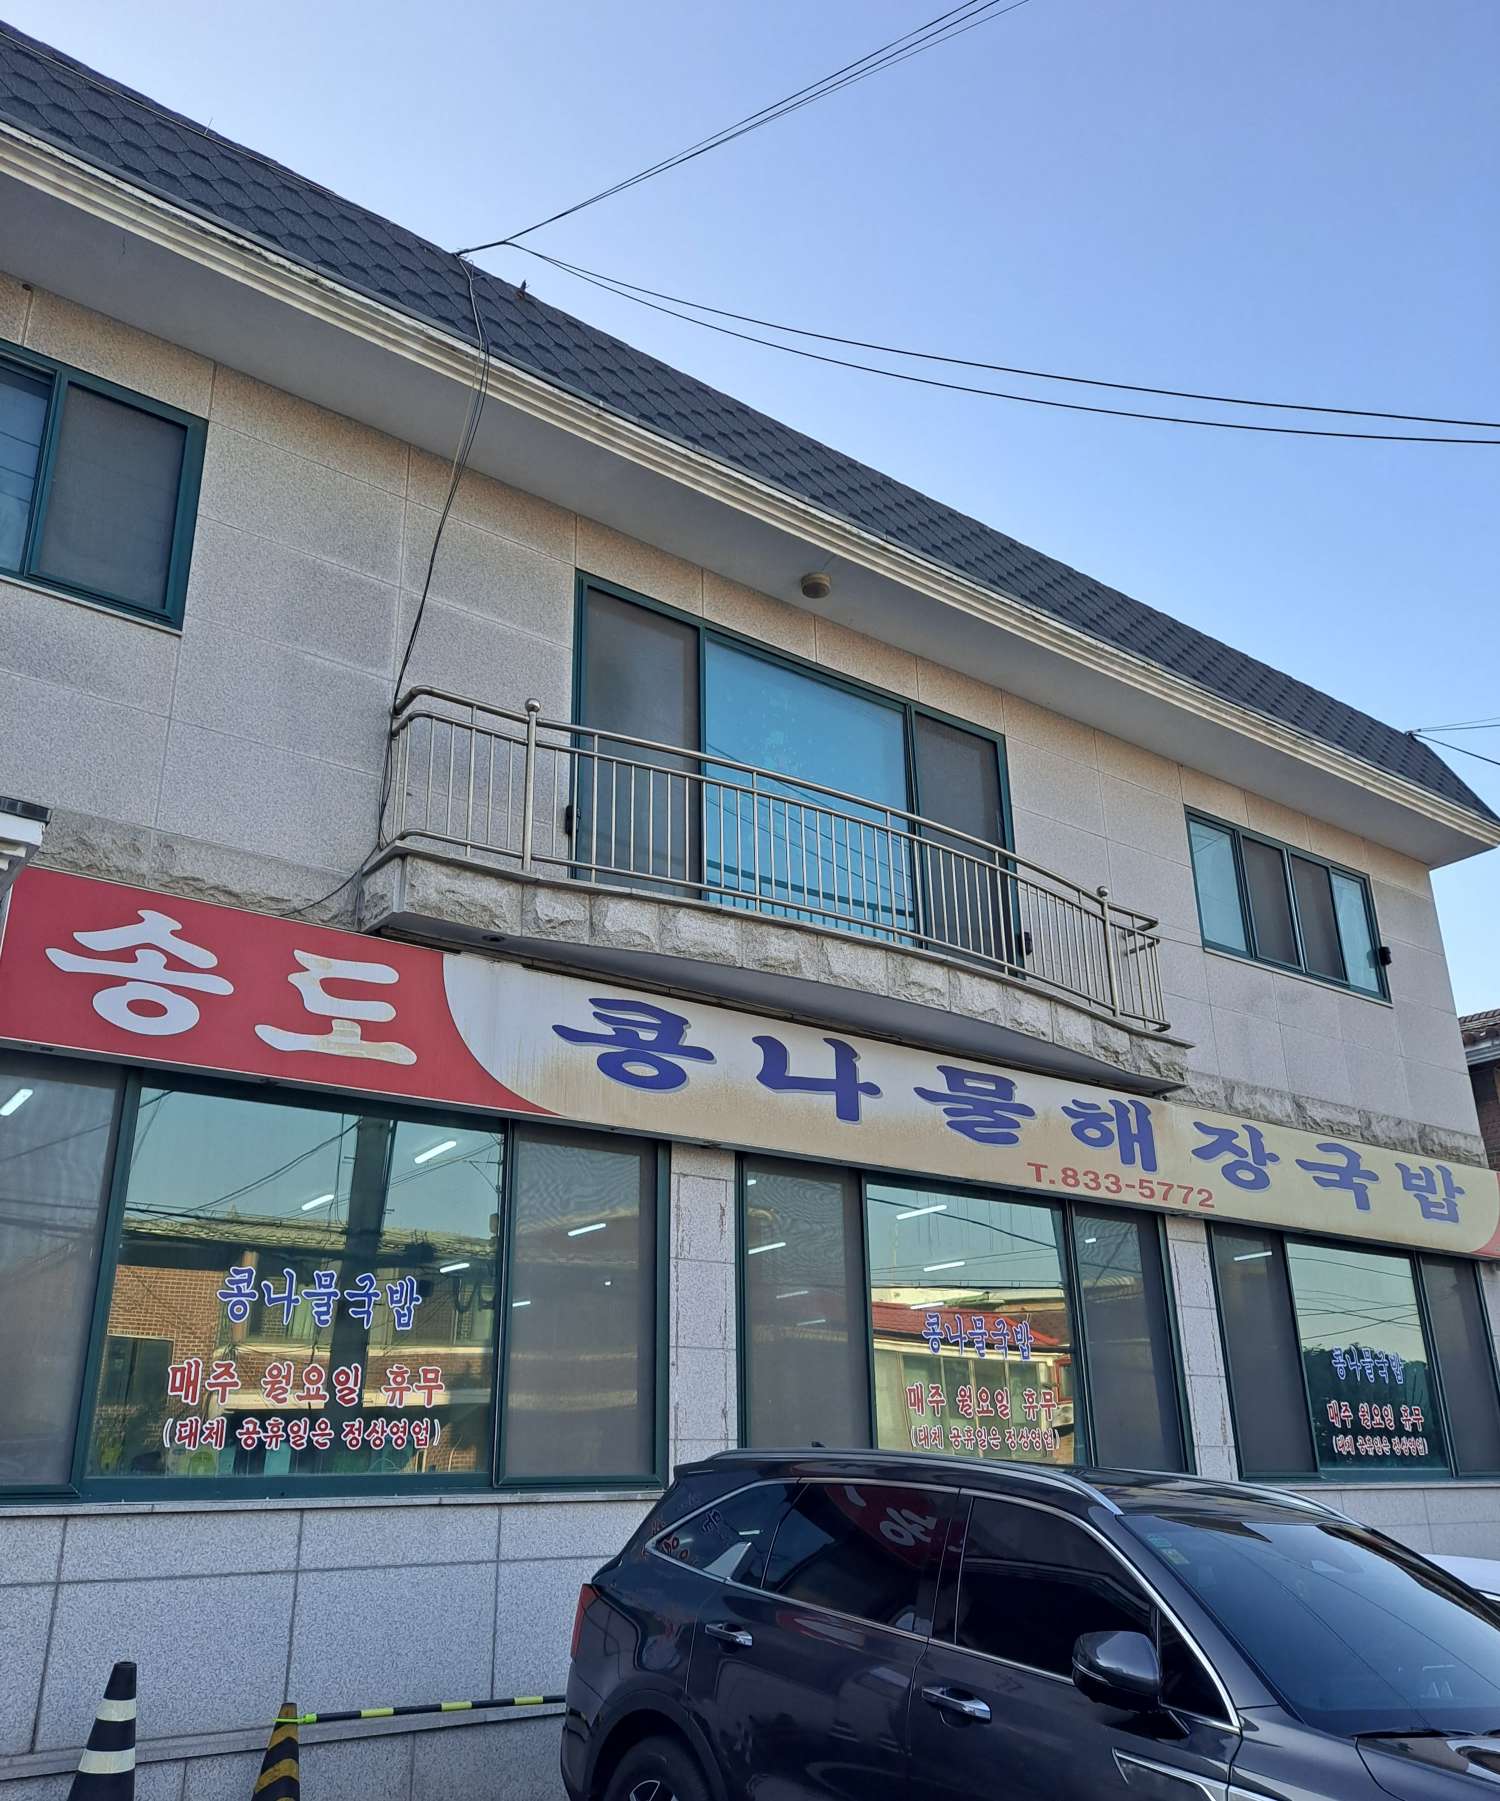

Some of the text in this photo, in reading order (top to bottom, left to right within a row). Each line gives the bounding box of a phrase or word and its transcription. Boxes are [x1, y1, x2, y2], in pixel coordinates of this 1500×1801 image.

[45, 909, 1467, 1224] 송도 콩나물해장국밥
[1026, 1161, 1216, 1209] T.833-5772
[217, 1266, 422, 1331] 콩나물국밥
[922, 1312, 1034, 1361] 콩나물국밥
[167, 1358, 445, 1408] 매주 월요일 휴무
[1331, 1344, 1404, 1384] 콩나물국밥
[905, 1381, 1058, 1421] 매주 월요일 휴무
[1326, 1400, 1424, 1432] 매주 월요일 휴무
[162, 1416, 442, 1450] (대체 공휴일은 정상영업)
[910, 1424, 1061, 1451] (대체 공휴일은 정상영업)
